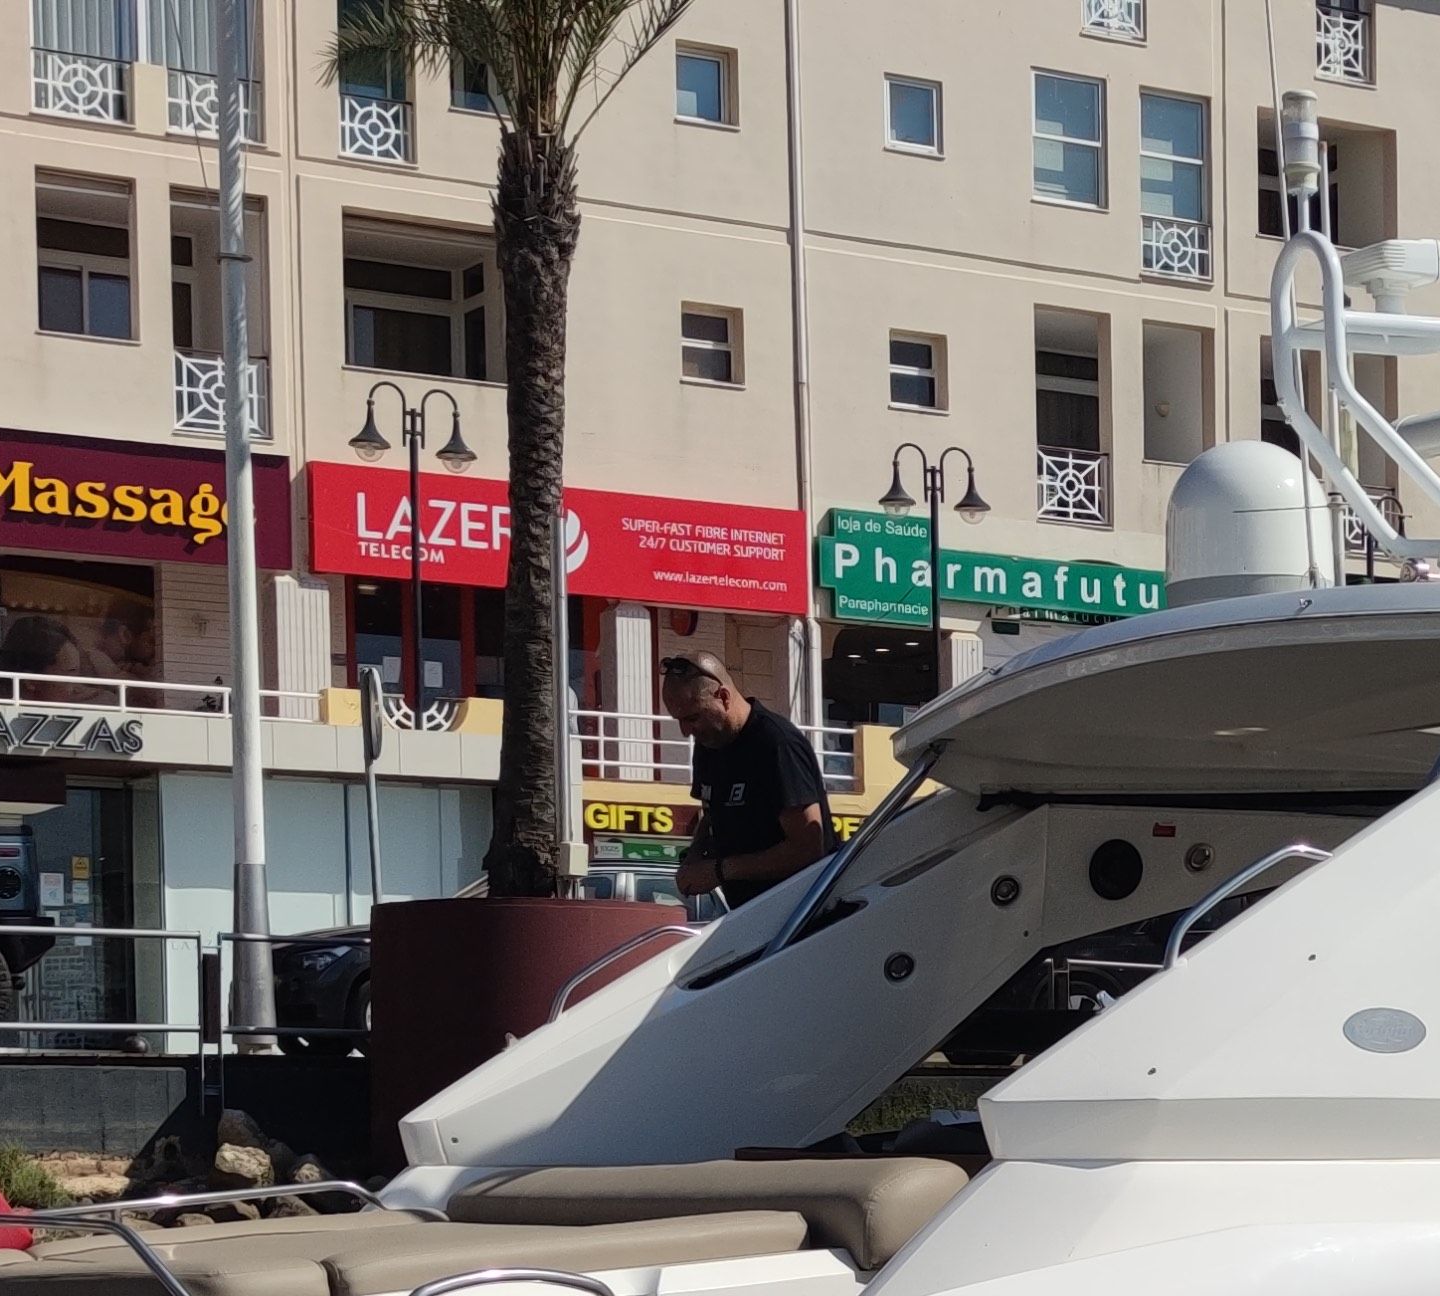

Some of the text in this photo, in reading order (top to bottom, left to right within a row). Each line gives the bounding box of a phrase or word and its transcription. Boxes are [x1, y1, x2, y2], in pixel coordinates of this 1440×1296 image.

[621, 517, 786, 545] SUPER-FAST FIBRE INTERNET
[864, 518, 882, 533] de
[885, 519, 928, 539] Saúde
[358, 541, 445, 564] TELECOM
[638, 535, 786, 561] 24/7 CUSTOMER SUPPORT
[653, 571, 788, 592] www.lazertelecom.com
[584, 802, 674, 833] GIFTS
